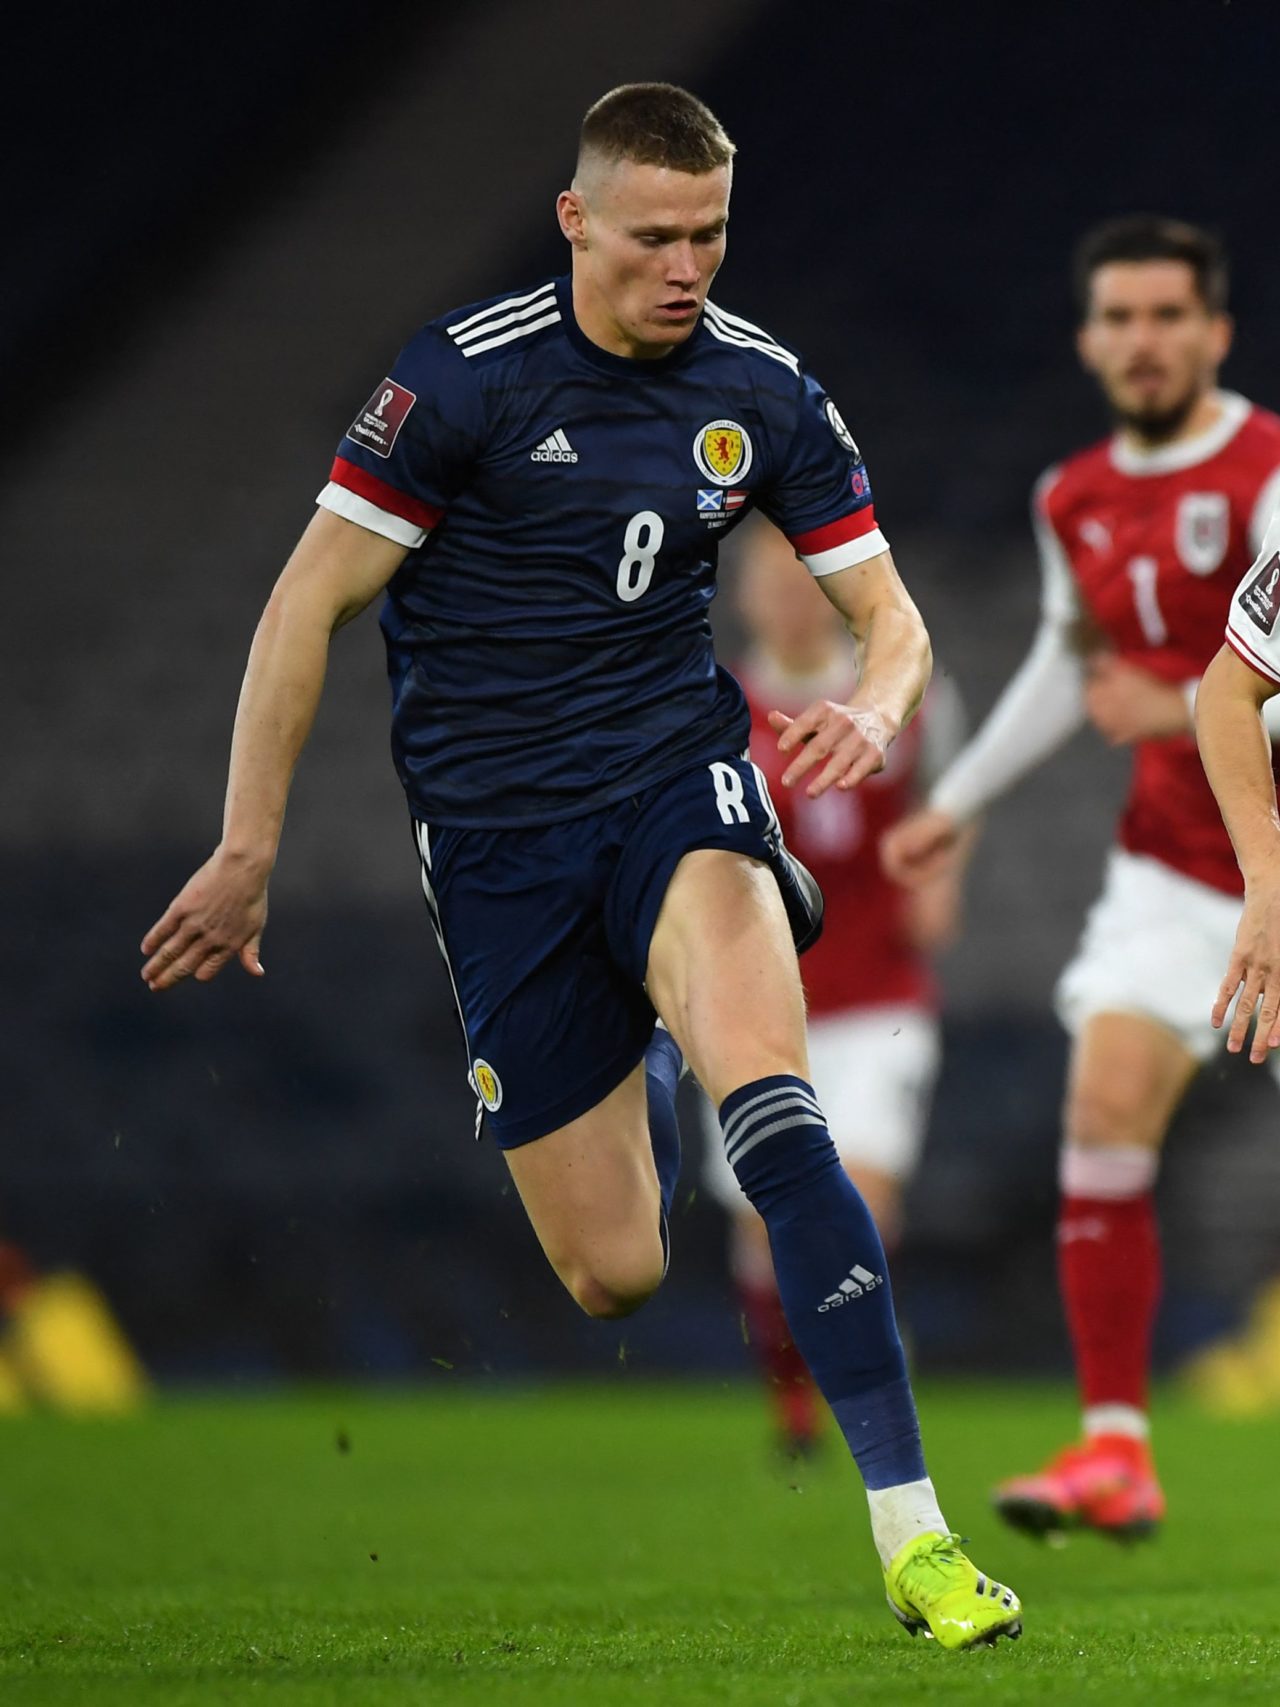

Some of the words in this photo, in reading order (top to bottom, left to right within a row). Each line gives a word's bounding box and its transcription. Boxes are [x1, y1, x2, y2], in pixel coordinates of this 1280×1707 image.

[531, 450, 578, 464] adidas
[617, 511, 664, 602] 8
[1128, 556, 1167, 646] 1
[817, 1275, 883, 1312] adidas
